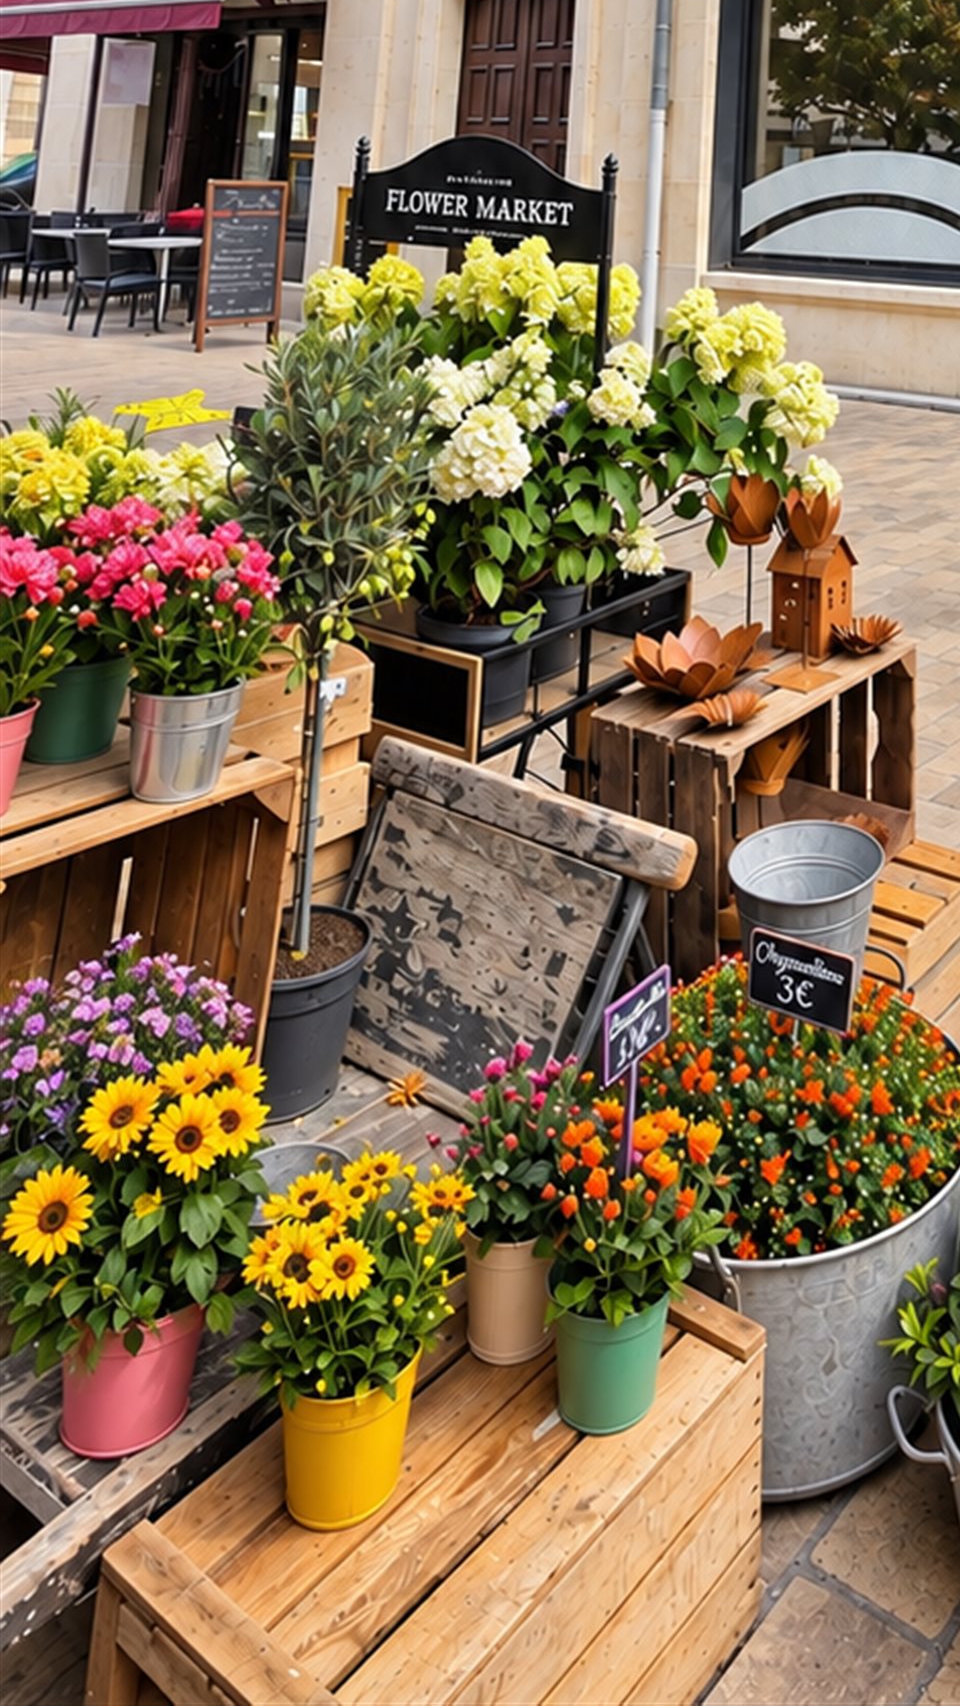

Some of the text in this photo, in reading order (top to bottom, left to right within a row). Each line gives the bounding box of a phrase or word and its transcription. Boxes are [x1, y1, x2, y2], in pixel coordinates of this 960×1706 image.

[385, 188, 574, 226] FLOWER MARKET
[776, 974, 814, 1008] 3€
